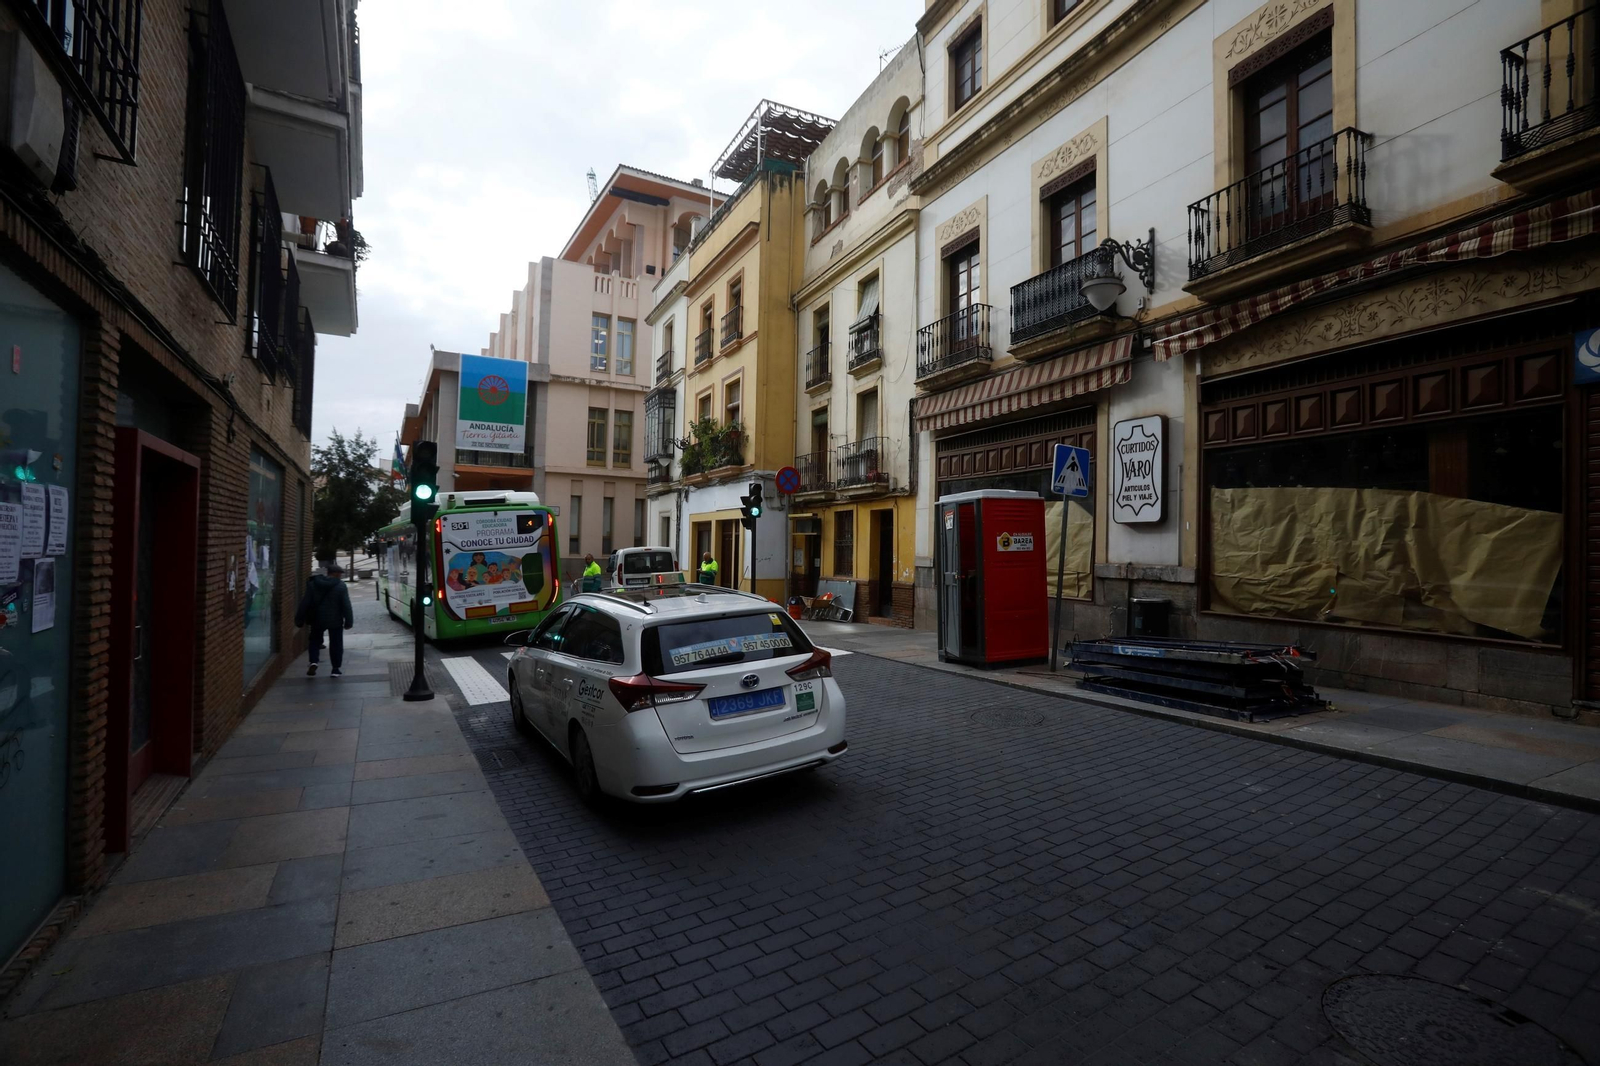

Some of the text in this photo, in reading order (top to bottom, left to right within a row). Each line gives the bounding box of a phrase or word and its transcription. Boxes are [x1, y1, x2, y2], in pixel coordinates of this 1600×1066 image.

[469, 423, 514, 433] ANDALUCÍA
[461, 430, 488, 440] Tierra
[1121, 441, 1155, 455] CURTIDOS
[1124, 458, 1151, 481] VARO
[452, 522, 469, 530] 301
[476, 528, 515, 537] PROGRAMA
[461, 535, 534, 548] CONOCE TU CIUDAD
[673, 653, 690, 665] 957
[694, 649, 704, 660] 76
[705, 648, 717, 658] 44
[717, 646, 728, 655] 44
[743, 640, 758, 651] 957
[760, 639, 770, 649] 45
[770, 639, 780, 648] 00
[780, 638, 790, 647] 00
[578, 679, 606, 700] Gestcor
[794, 682, 813, 692] 129C
[720, 697, 754, 716] 2369
[758, 693, 782, 710] JKF
